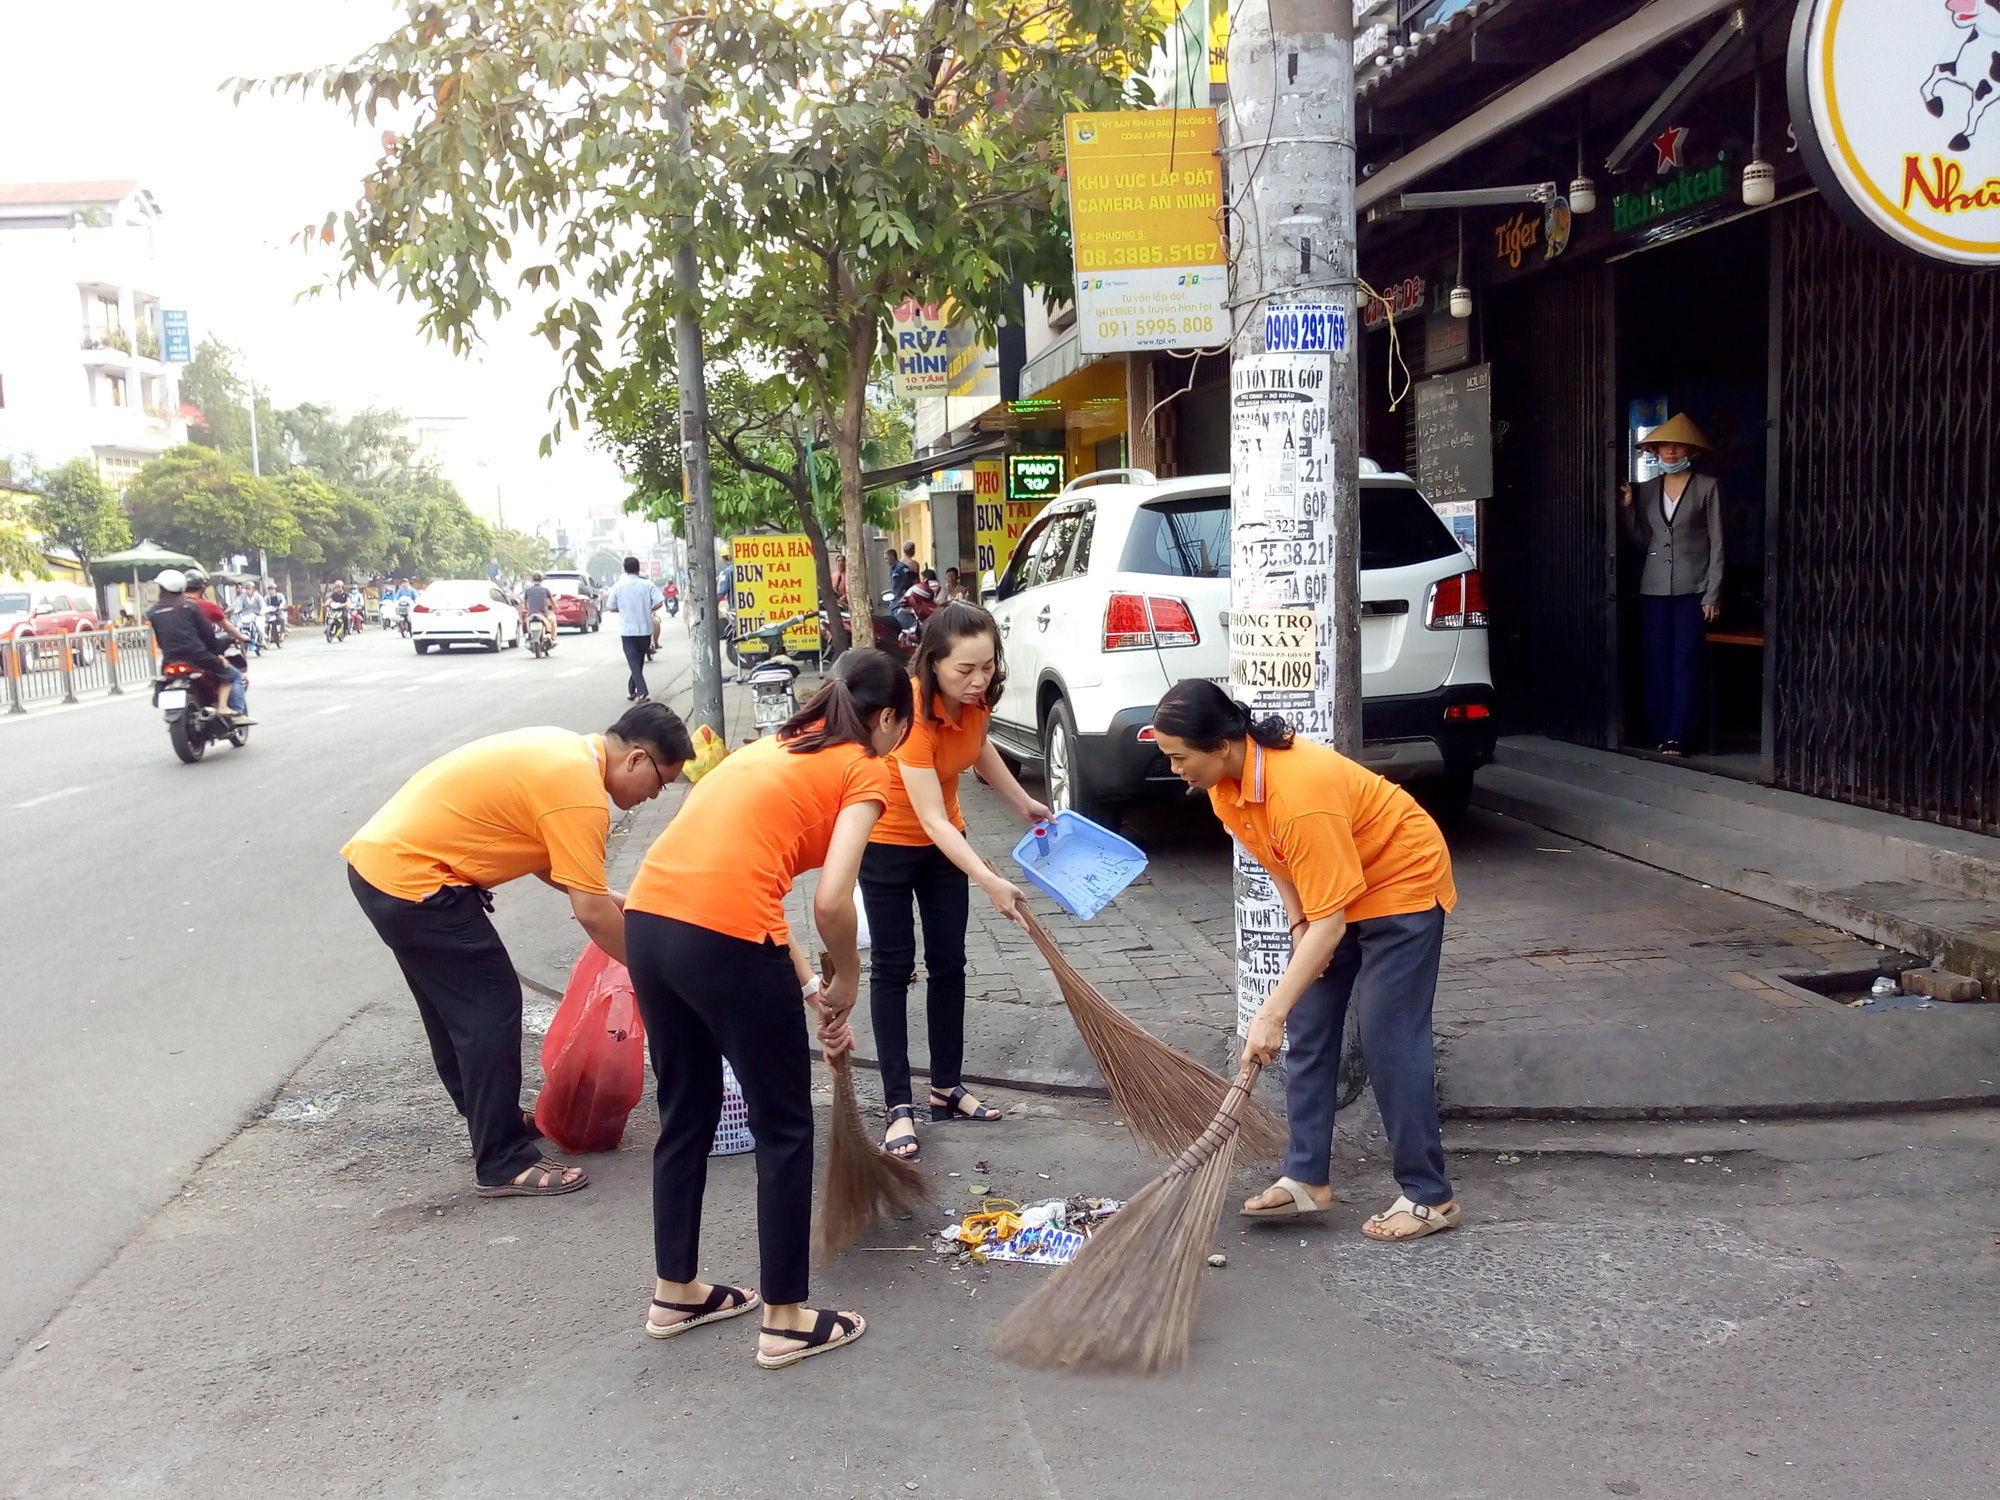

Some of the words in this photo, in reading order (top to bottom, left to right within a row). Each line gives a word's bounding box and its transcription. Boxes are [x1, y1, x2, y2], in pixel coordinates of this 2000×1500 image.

[1076, 175, 1110, 190] KHU
[1114, 173, 1146, 192] VỰC
[1184, 168, 1214, 188] ĐẶT
[1078, 196, 1144, 213] CAMERA
[1148, 195, 1172, 210] AN
[1176, 193, 1217, 208] NINH
[1613, 164, 1724, 231] Heineken
[1080, 232, 1094, 242] CA
[1495, 212, 1540, 268] Tiger
[1082, 243, 1218, 267] 08.3885.5167
[1082, 278, 1103, 292] FPT
[1178, 272, 1199, 287] FPT
[1096, 306, 1137, 317] INTERNET
[1139, 306, 1145, 314] &
[1098, 316, 1213, 338] 091.5995.808
[1266, 313, 1344, 351] 0909.293.769
[1136, 338, 1176, 346] www.fpt.vn
[1298, 364, 1323, 389] GÓP
[1017, 463, 1056, 476] PIANO
[977, 498, 1004, 532] BÚN
[734, 538, 759, 558] PHỞ
[762, 542, 784, 558] GIA
[978, 539, 994, 572] BÒ
[736, 560, 763, 582] BÚN
[766, 561, 790, 573] TÁI
[768, 578, 802, 590] NẠM
[738, 588, 754, 610] BÒ
[1230, 610, 1270, 628] PHÒNG
[1274, 614, 1312, 632] TRỌ
[1232, 630, 1254, 646] MỚI
[1261, 632, 1306, 648] XÂY
